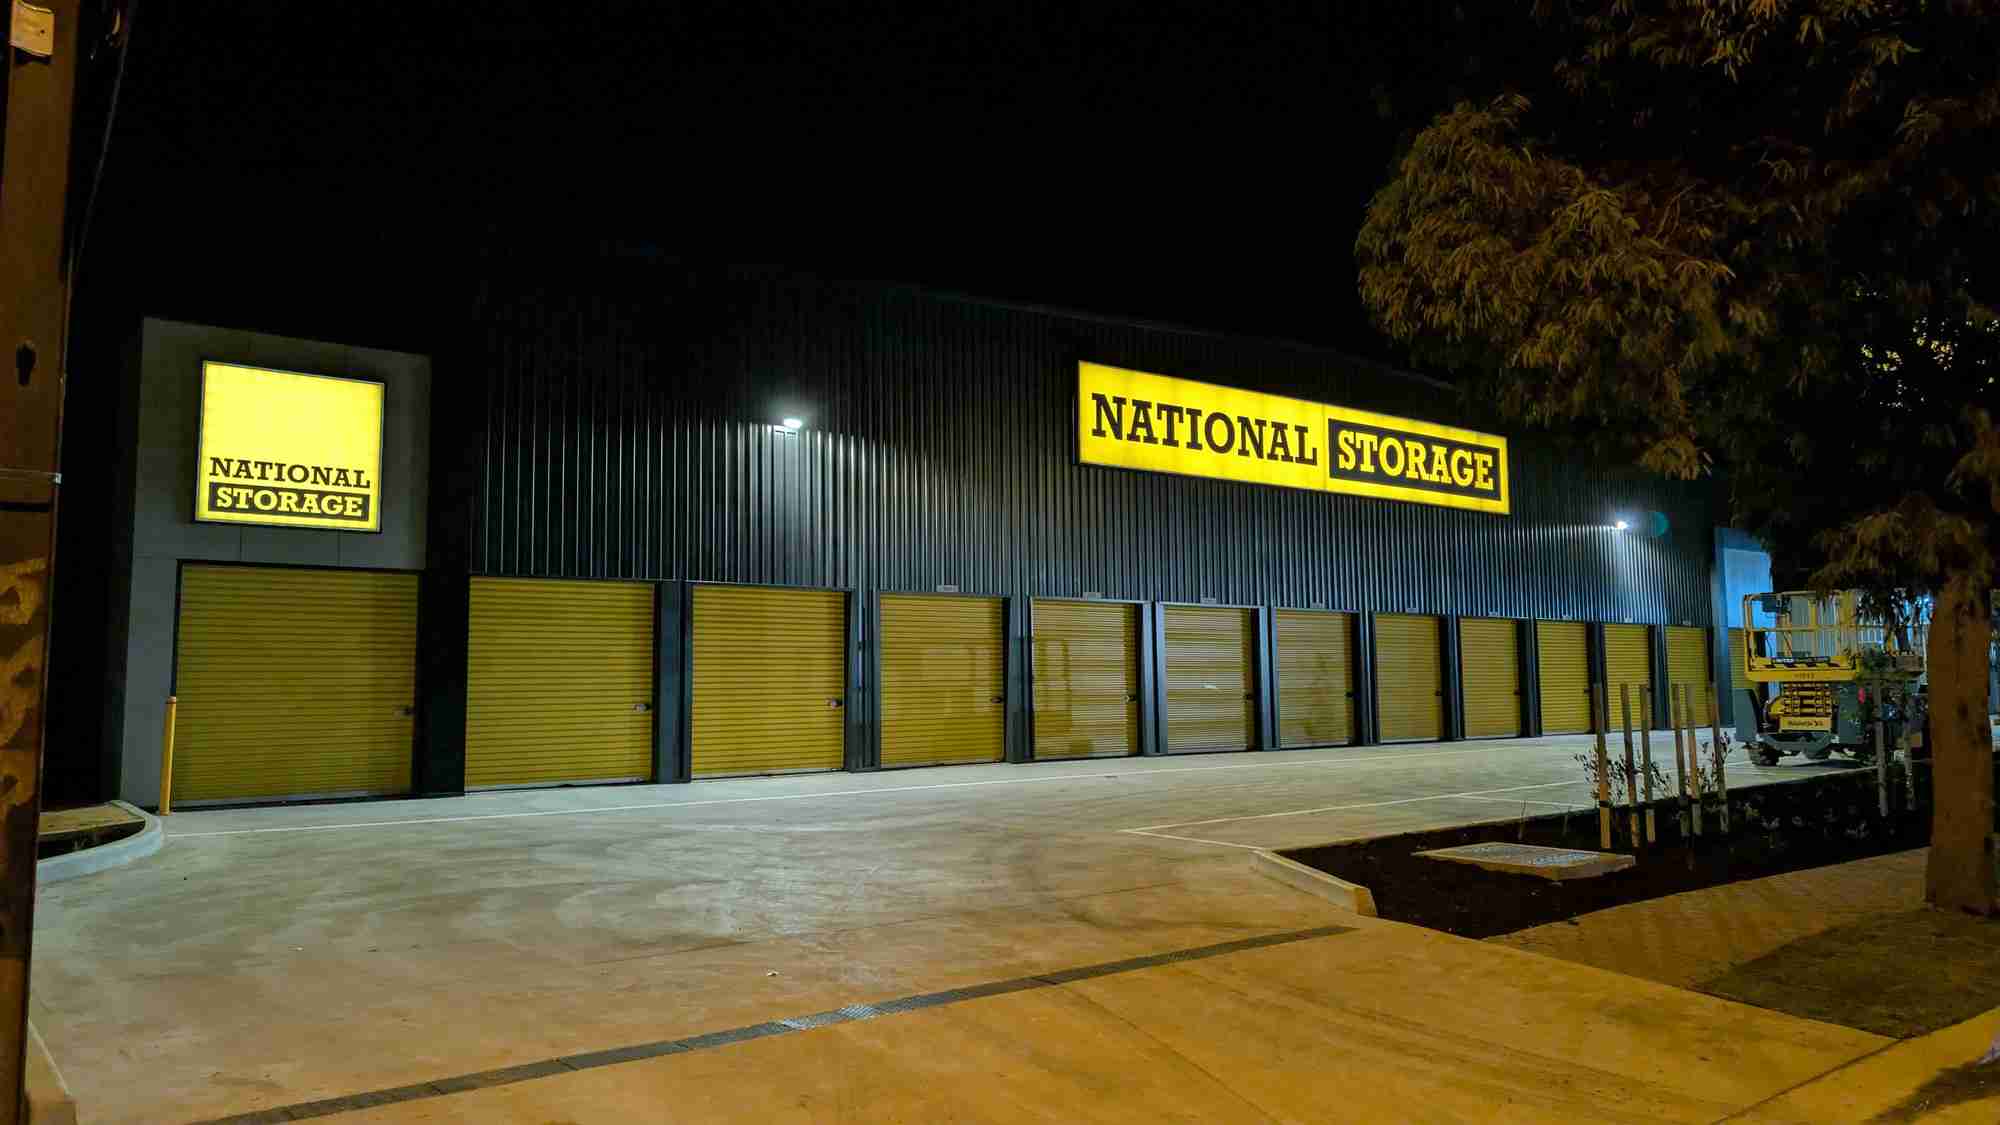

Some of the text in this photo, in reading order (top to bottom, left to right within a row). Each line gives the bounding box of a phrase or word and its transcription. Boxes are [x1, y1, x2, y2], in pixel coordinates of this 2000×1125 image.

[1091, 393, 1494, 490] NATIONAL STORAGE
[209, 457, 370, 488] NATIONAL
[216, 487, 363, 517] STORAGE
